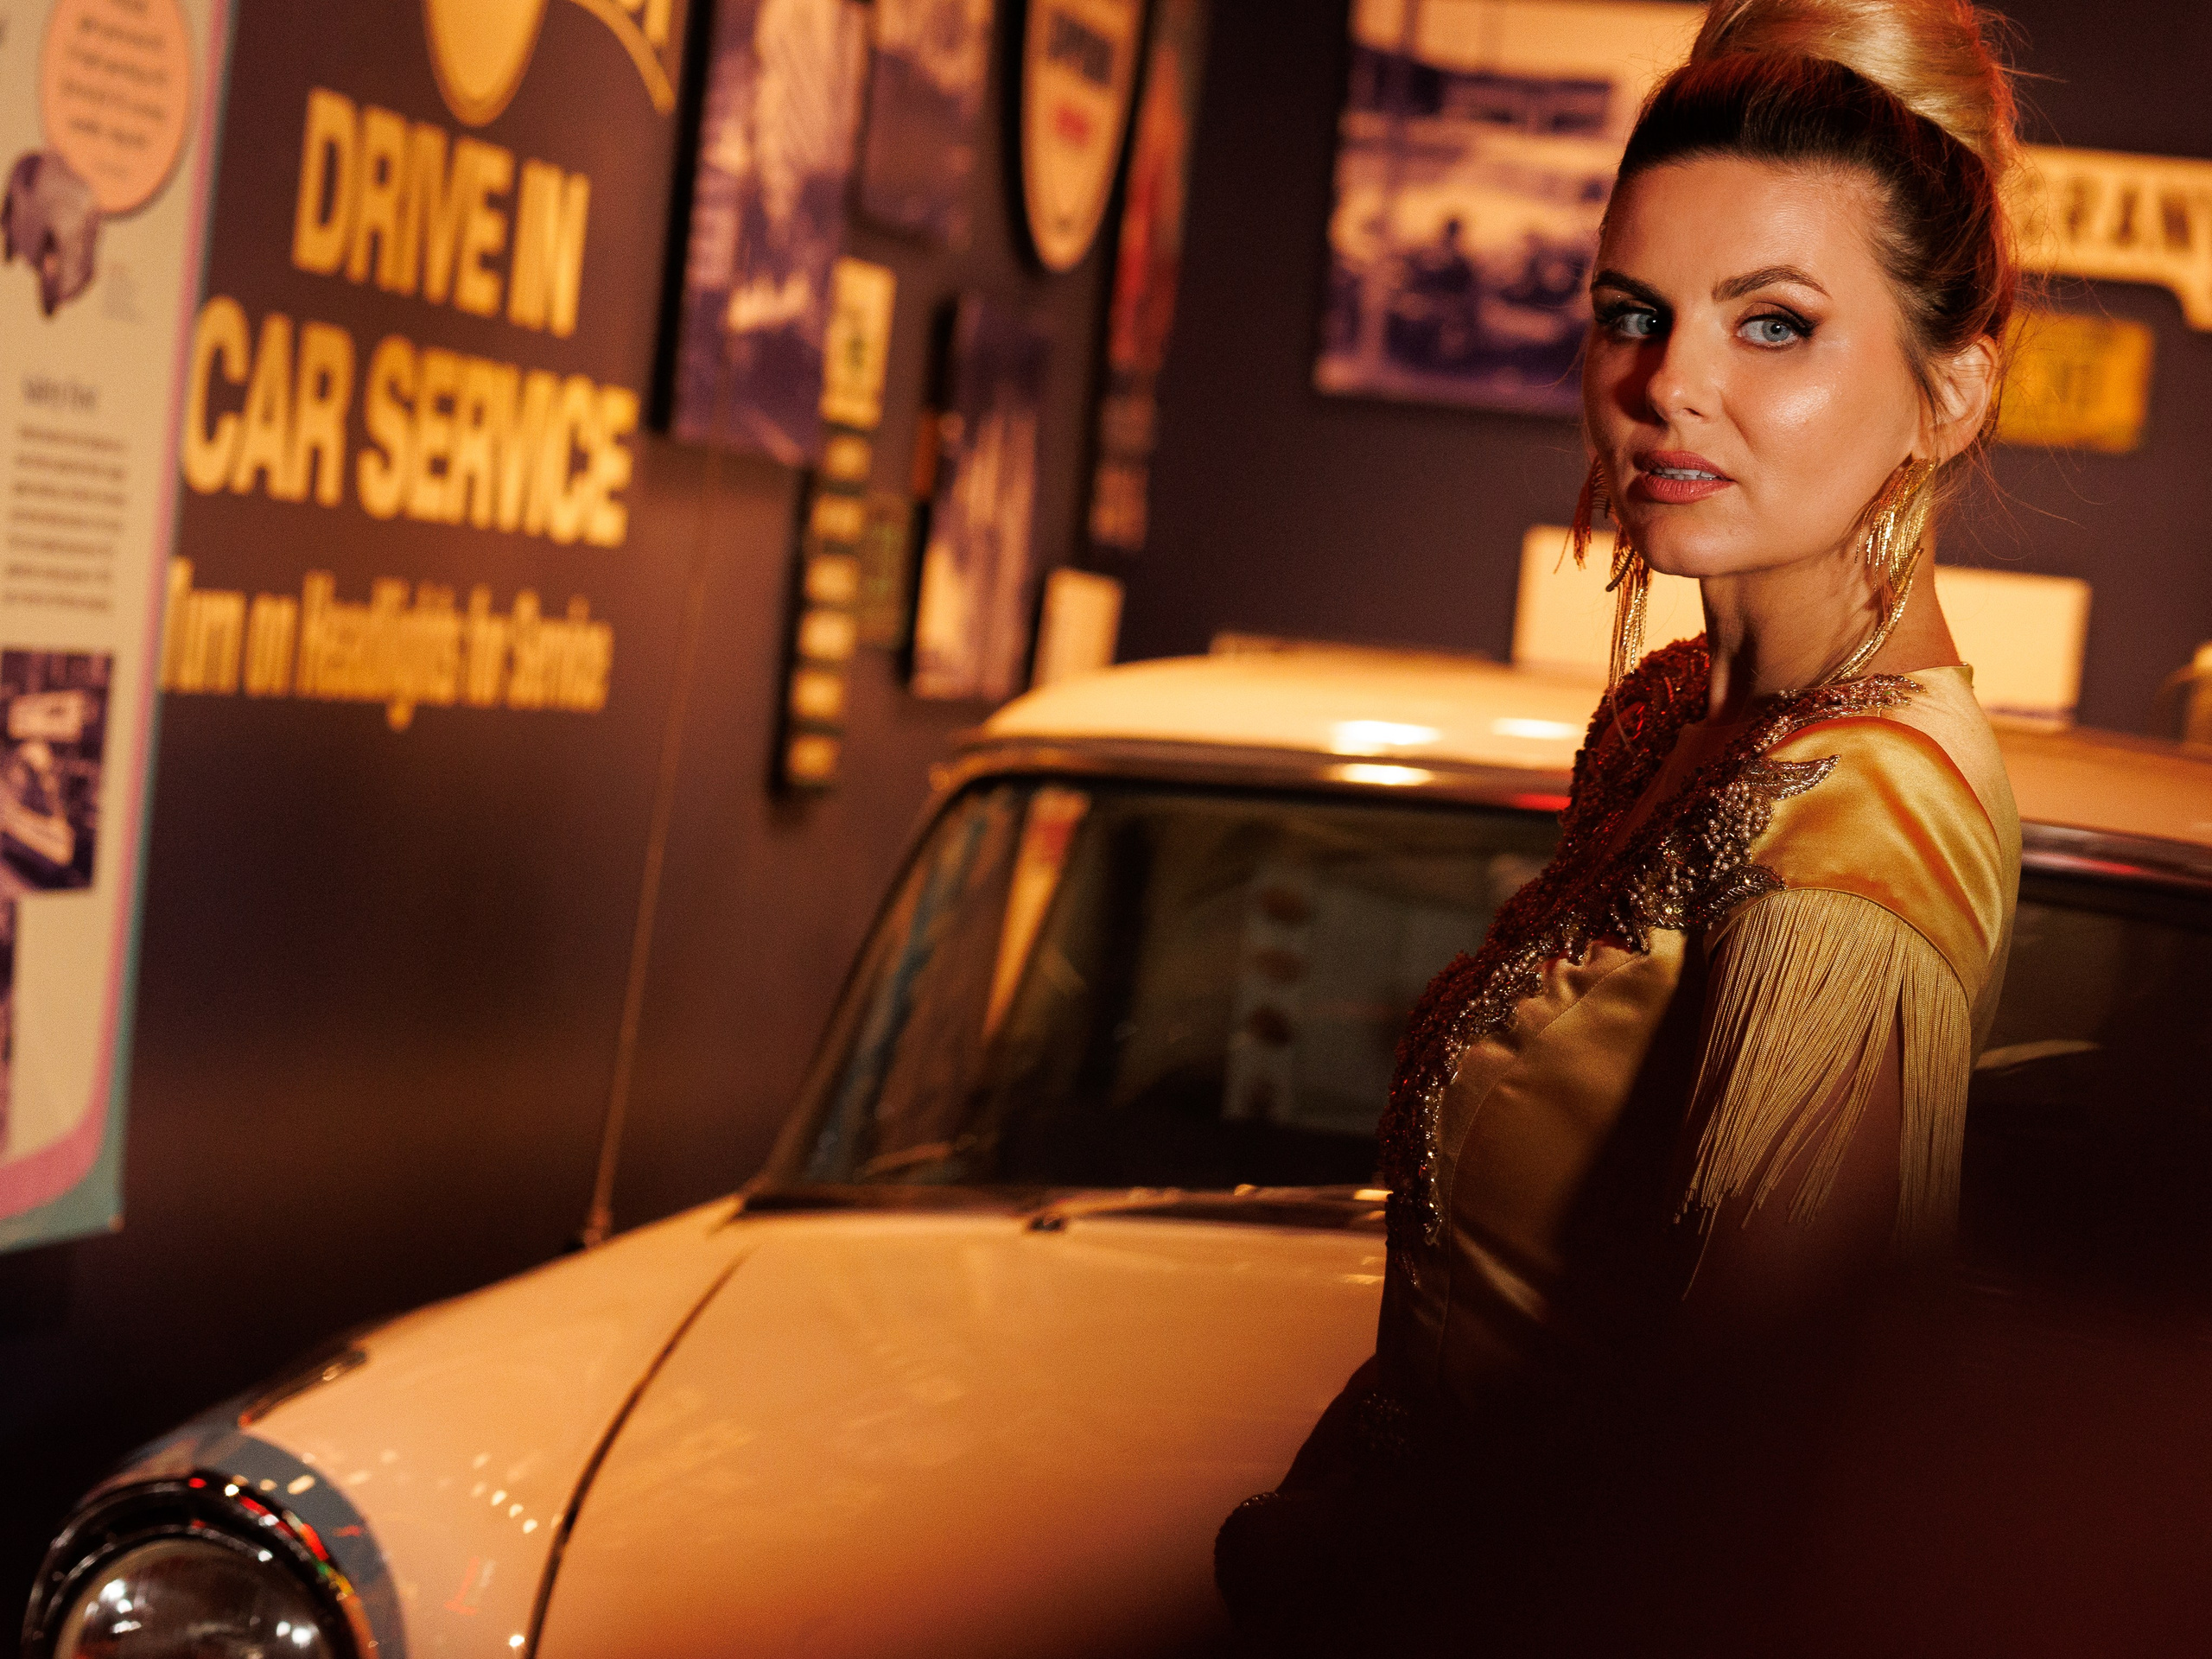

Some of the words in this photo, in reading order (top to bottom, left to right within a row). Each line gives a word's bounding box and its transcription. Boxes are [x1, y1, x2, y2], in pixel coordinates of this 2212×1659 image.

[294, 88, 514, 316] DRIVE
[507, 158, 589, 339] IN
[183, 296, 354, 507] CAR
[357, 335, 639, 547] SERVICE
